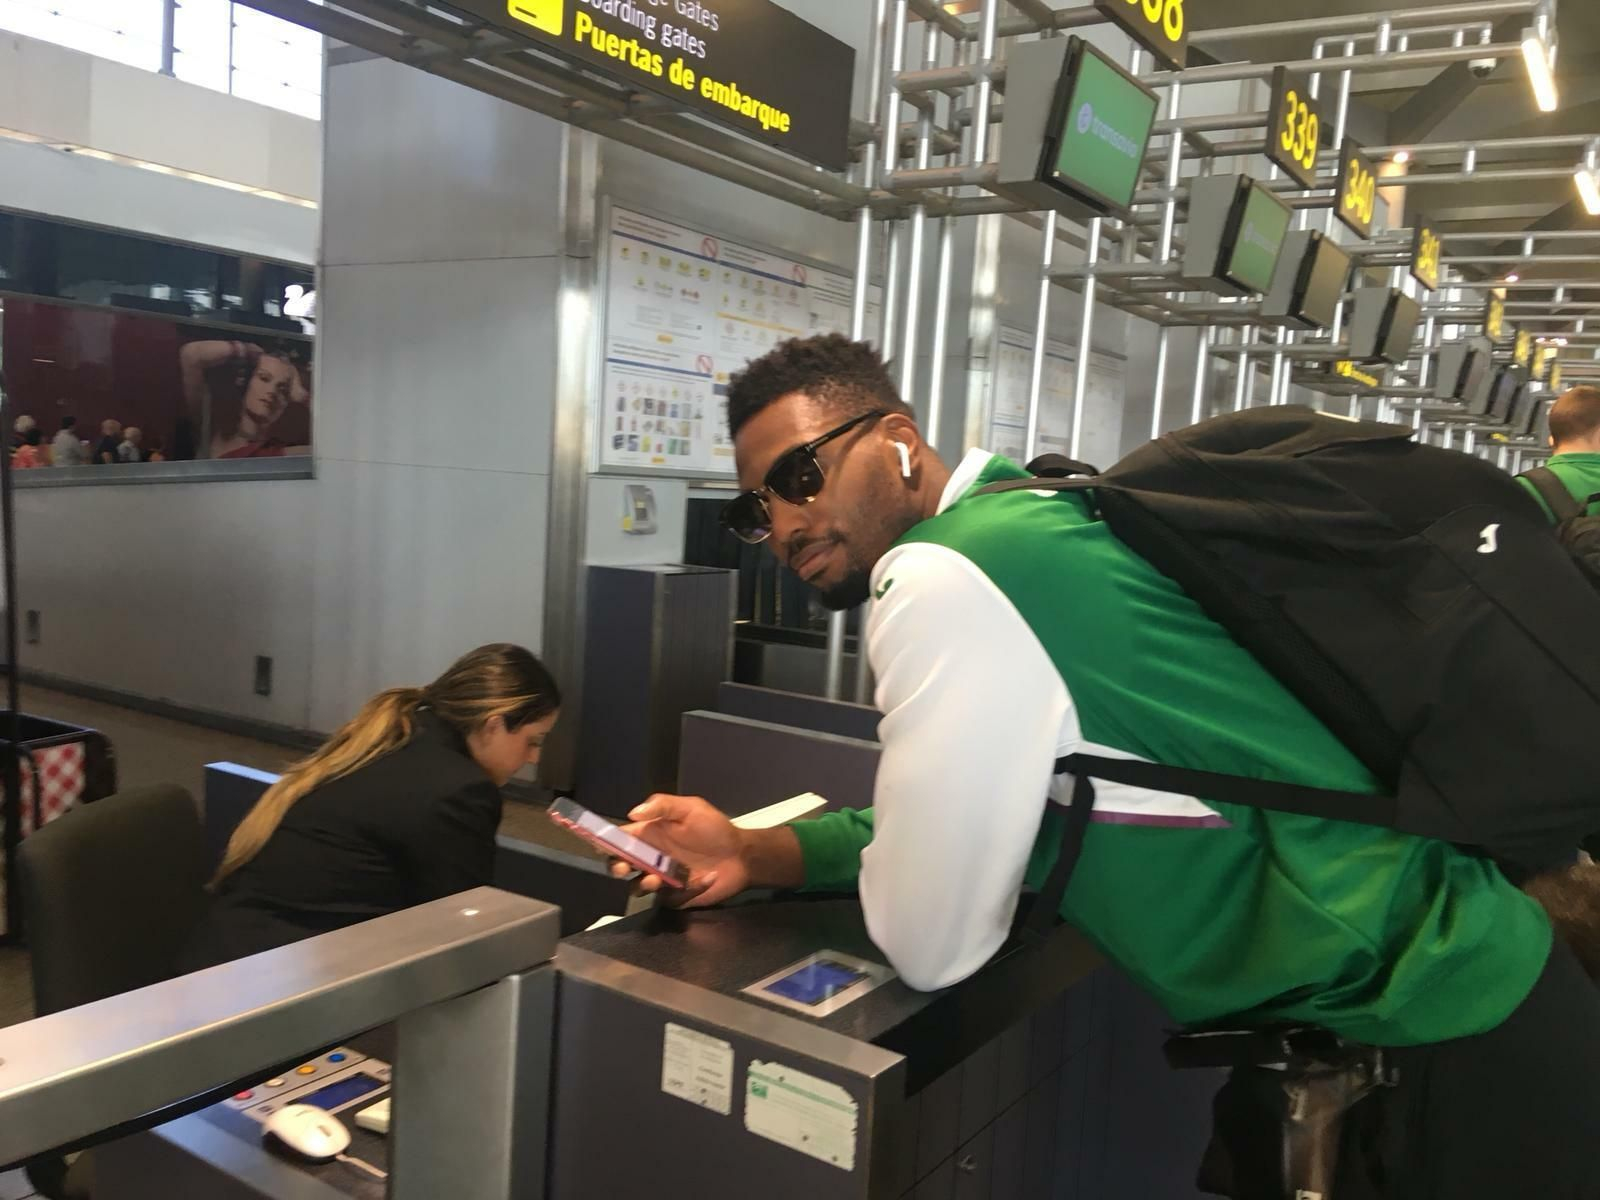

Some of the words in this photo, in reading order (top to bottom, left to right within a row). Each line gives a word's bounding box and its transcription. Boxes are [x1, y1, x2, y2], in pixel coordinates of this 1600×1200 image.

[660, 23, 706, 59] gates
[674, 0, 719, 31] Gates
[575, 10, 663, 77] Puertas
[669, 58, 695, 91] de
[700, 75, 791, 133] embarque
[1280, 90, 1319, 169] 339
[1345, 158, 1375, 225] 340
